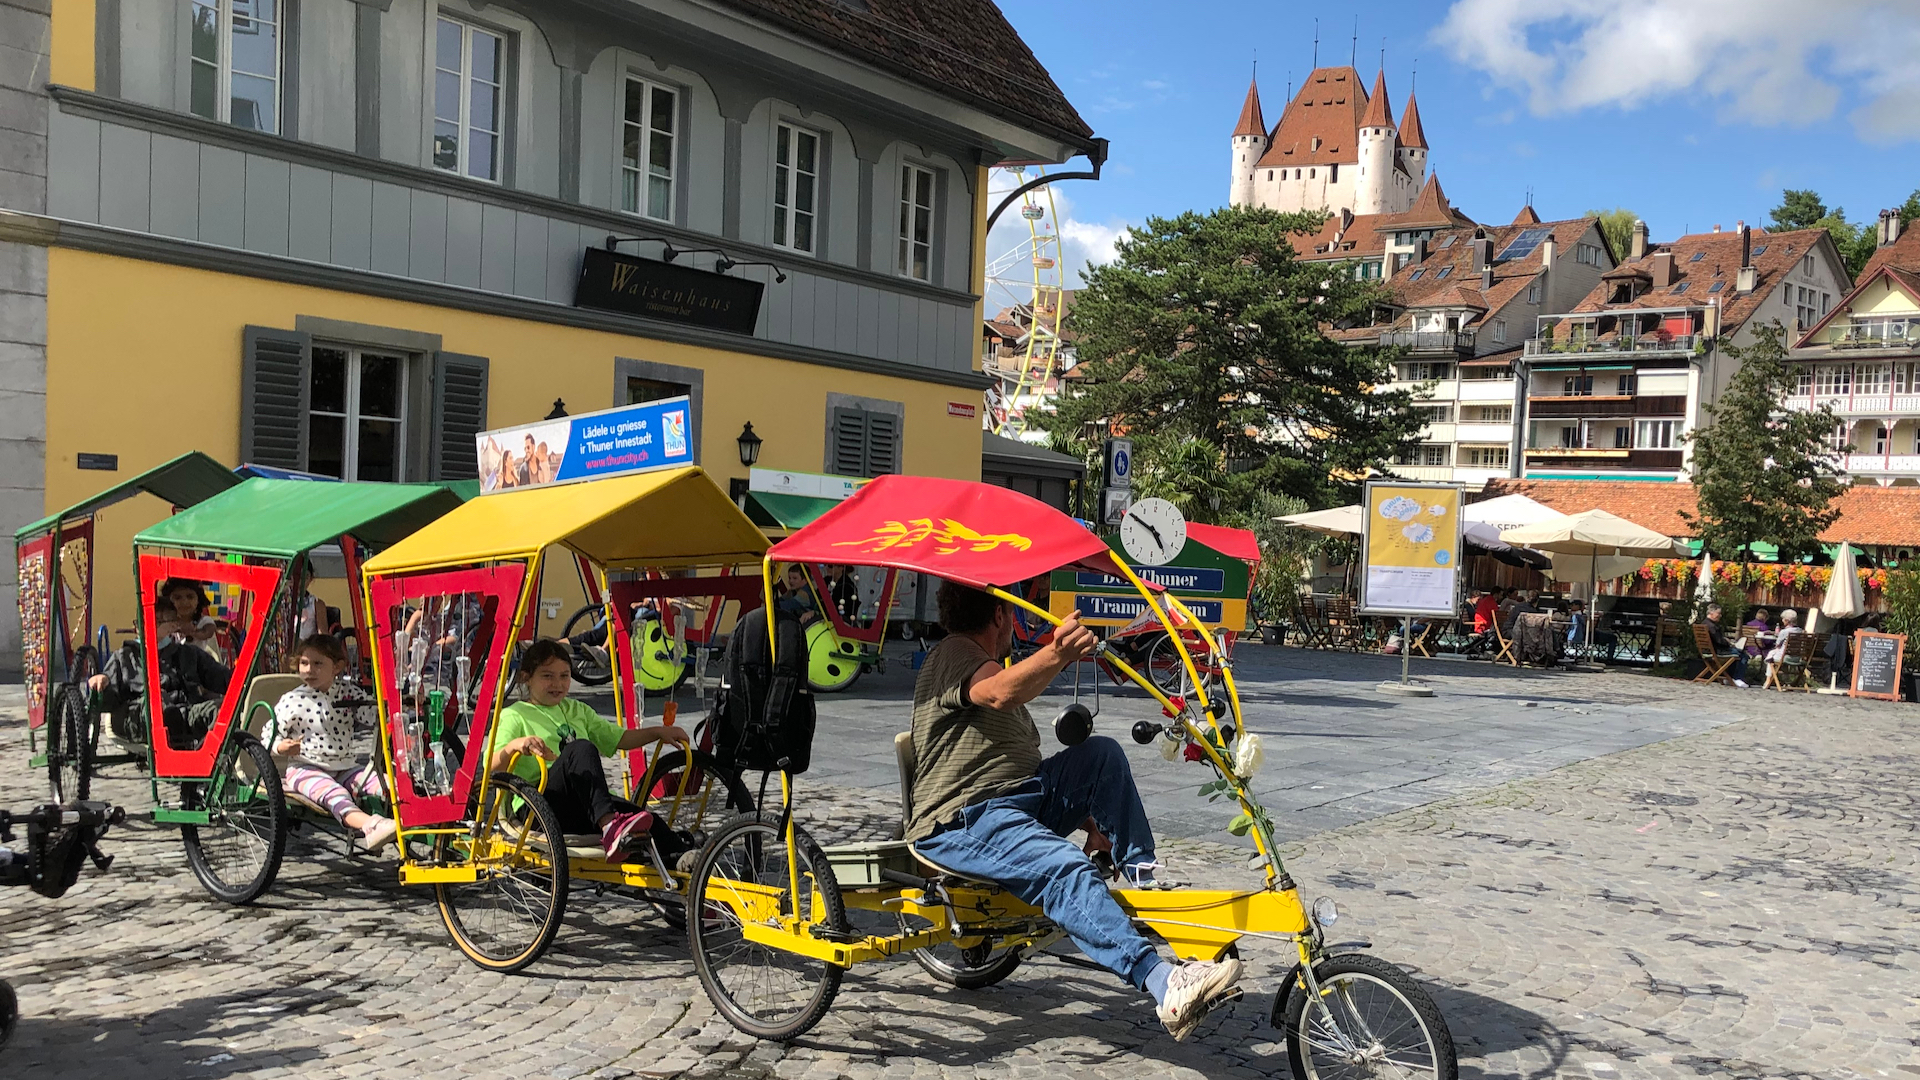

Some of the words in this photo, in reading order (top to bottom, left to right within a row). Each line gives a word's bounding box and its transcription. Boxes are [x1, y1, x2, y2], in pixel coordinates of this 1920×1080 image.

[611, 262, 731, 311] Waisenhaus
[679, 305, 692, 316] bar
[610, 425, 616, 435] u
[617, 419, 647, 436] gniesse
[579, 443, 586, 455] ir
[586, 440, 614, 454] Thuner
[614, 431, 653, 449] Innestadt
[666, 440, 685, 451] THUN
[585, 449, 649, 469] www.thuncity.ch
[1138, 569, 1198, 587] Thuner
